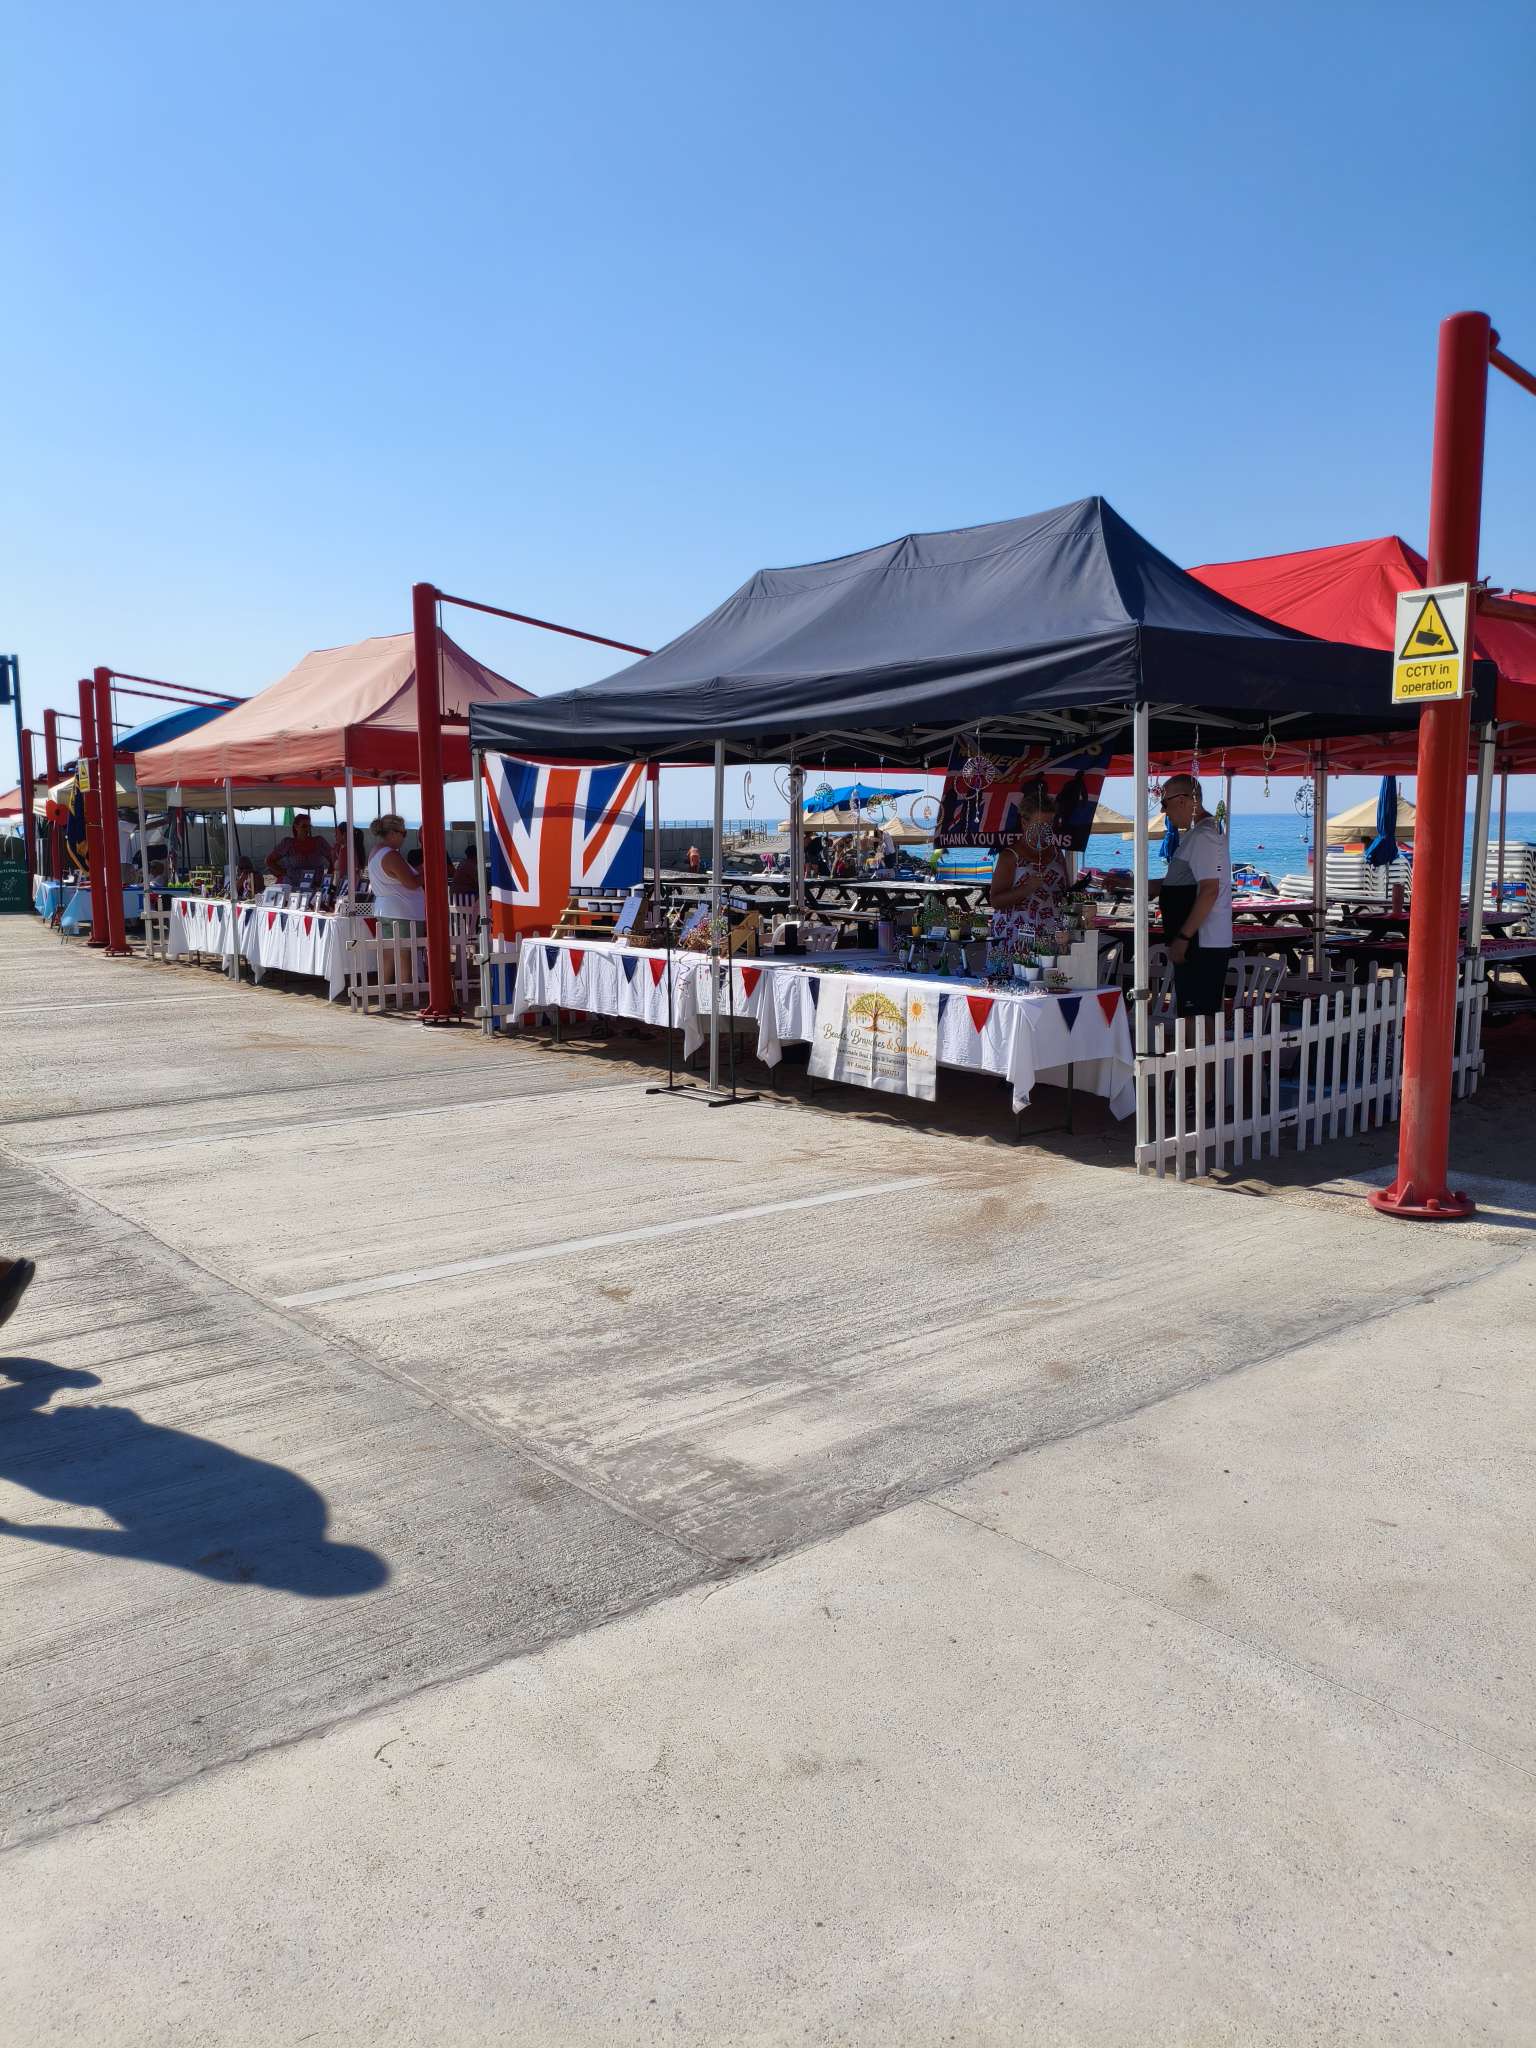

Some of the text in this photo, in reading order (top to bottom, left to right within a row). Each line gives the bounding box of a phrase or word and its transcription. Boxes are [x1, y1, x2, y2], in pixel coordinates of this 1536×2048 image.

[1406, 664, 1450, 678] CCTV in
[1401, 680, 1452, 695] operation
[940, 833, 969, 847] THANK
[972, 834, 995, 846] YOU
